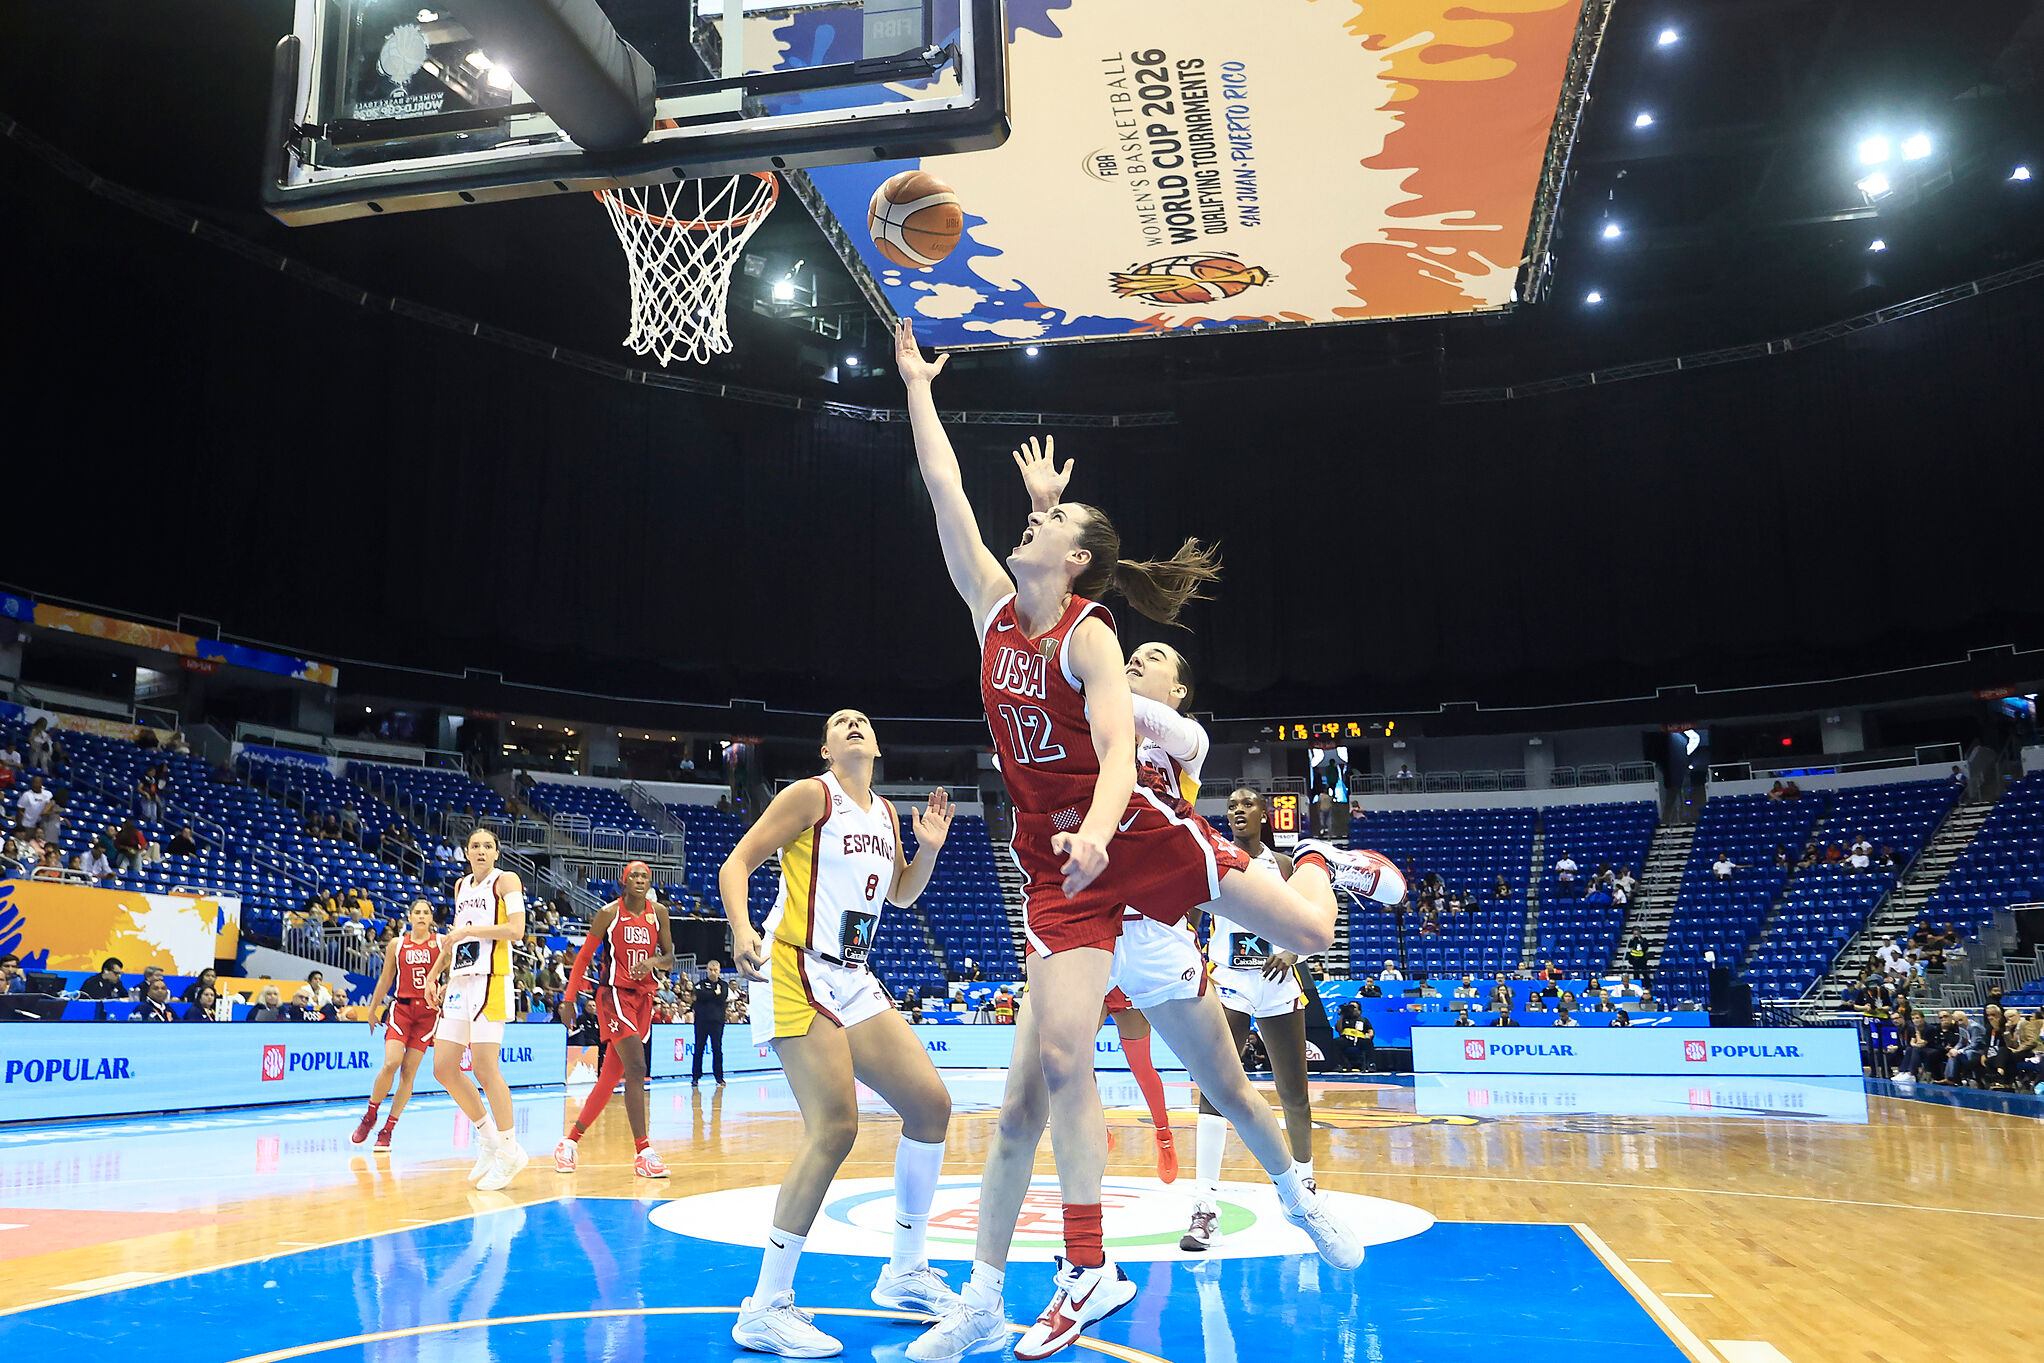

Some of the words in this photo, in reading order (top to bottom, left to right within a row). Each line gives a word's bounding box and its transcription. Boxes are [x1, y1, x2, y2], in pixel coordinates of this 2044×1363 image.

[1131, 48, 1175, 117] 2026
[1220, 61, 1248, 100] RICO
[1101, 51, 1147, 174] BASKETBALL
[1176, 58, 1217, 168] TOURNAMENTS
[1145, 123, 1185, 169] CUP
[1095, 154, 1119, 176] FIBA
[1129, 179, 1163, 247] WOMEN'S
[1157, 175, 1198, 245] WORLD
[1193, 169, 1228, 235] QUALIFYING
[1237, 205, 1261, 228] SAN
[992, 646, 1047, 700] USA
[999, 704, 1067, 764] 12
[1273, 795, 1297, 809] 1:52
[1273, 808, 1294, 831] 18
[865, 873, 880, 902] 8
[624, 926, 651, 945] USA
[405, 948, 431, 965] USA
[411, 966, 426, 990] 5
[289, 1050, 370, 1072] POPULAR
[499, 1046, 533, 1063] ULAR
[1489, 1044, 1575, 1057] POPULAR
[1711, 1045, 1801, 1058] POPULAR
[5, 1057, 131, 1083] POPULAR
